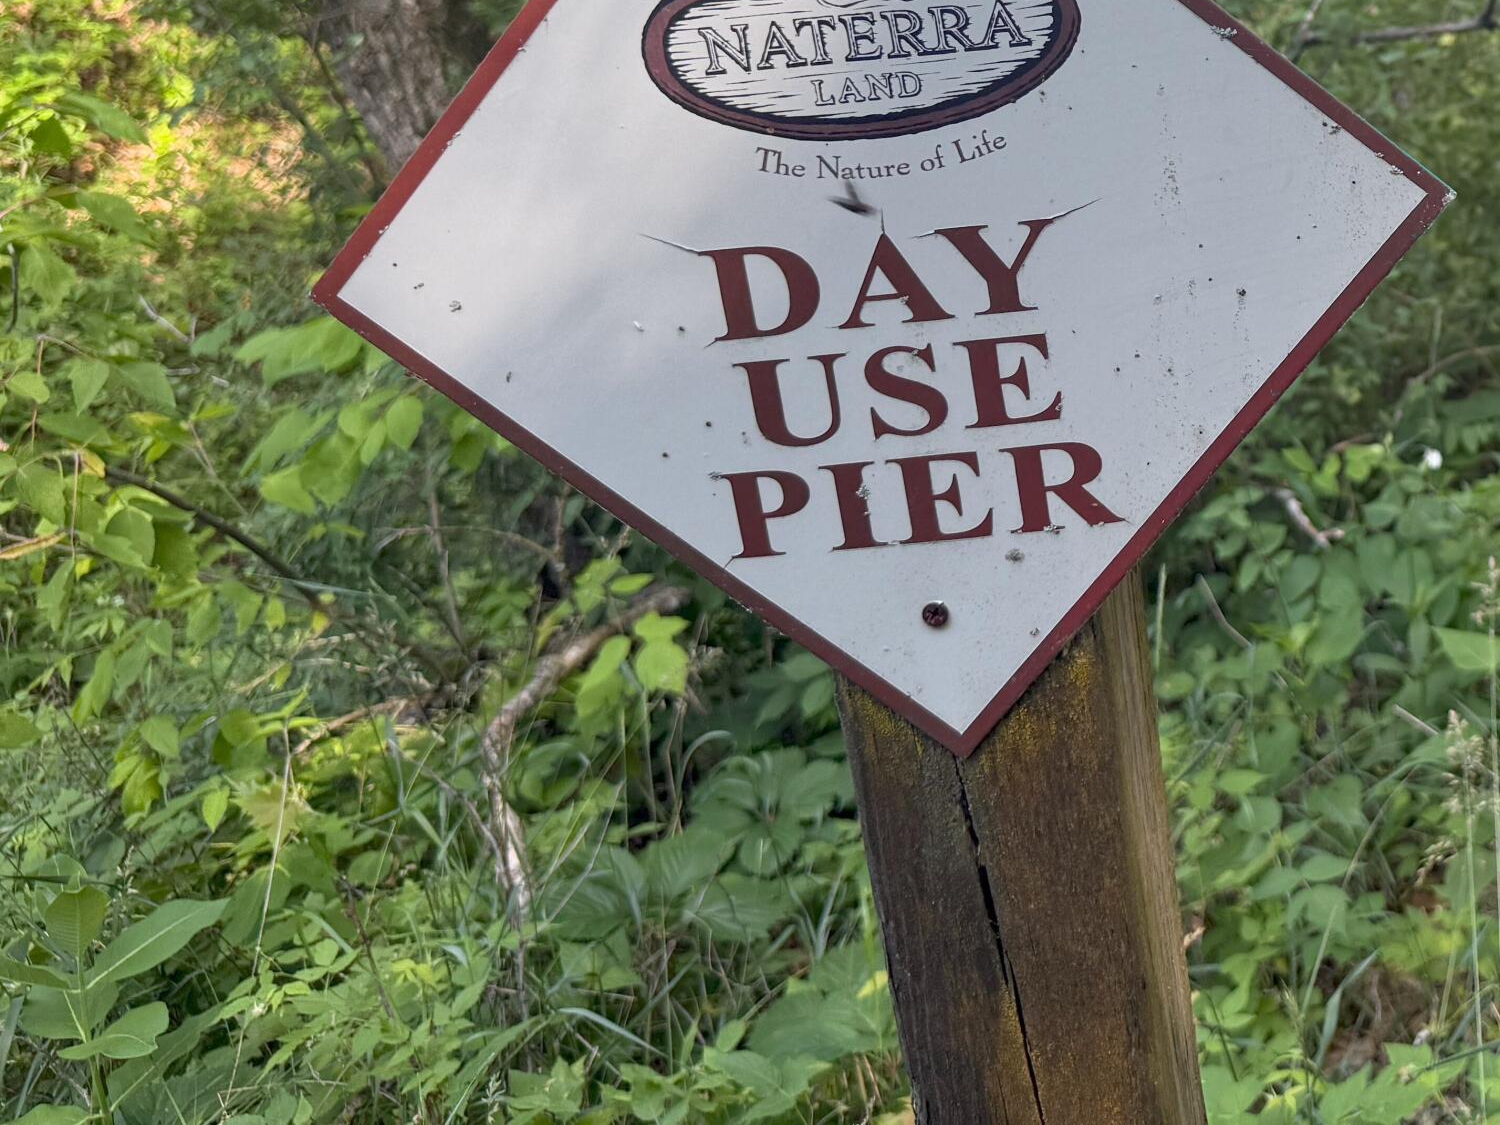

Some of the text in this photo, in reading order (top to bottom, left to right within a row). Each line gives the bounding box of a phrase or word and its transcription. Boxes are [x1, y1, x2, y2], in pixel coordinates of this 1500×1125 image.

[698, 0, 1033, 76] NATERRA
[811, 71, 922, 106] LAND
[755, 129, 1007, 180] The Nature of Life
[699, 218, 1055, 341] DAY
[732, 332, 1062, 447] USE
[720, 441, 1128, 559] PIER
